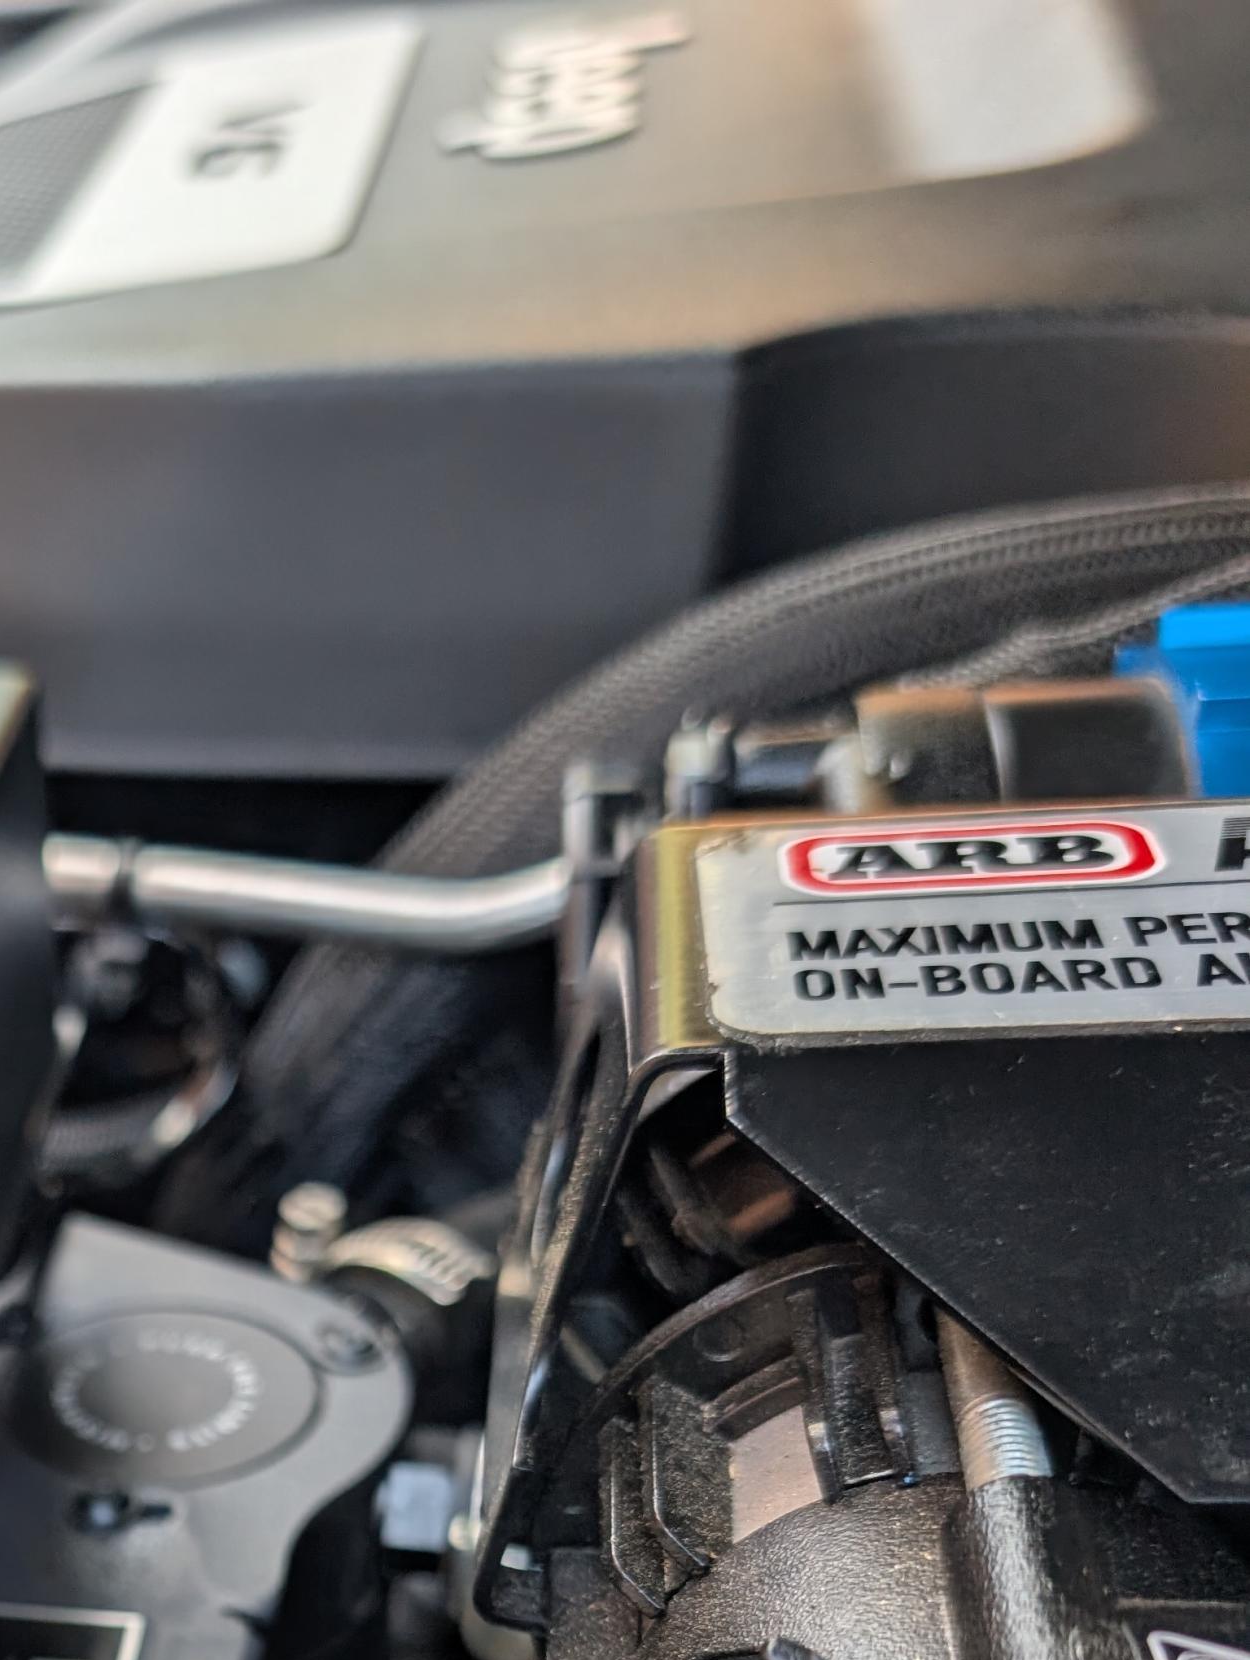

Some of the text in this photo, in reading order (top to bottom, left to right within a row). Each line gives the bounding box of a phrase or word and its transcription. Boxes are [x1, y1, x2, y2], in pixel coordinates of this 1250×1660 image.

[828, 834, 1116, 881] ARB
[787, 918, 1103, 962] MAXIMUM
[792, 956, 1163, 1001] ON-BOARD
